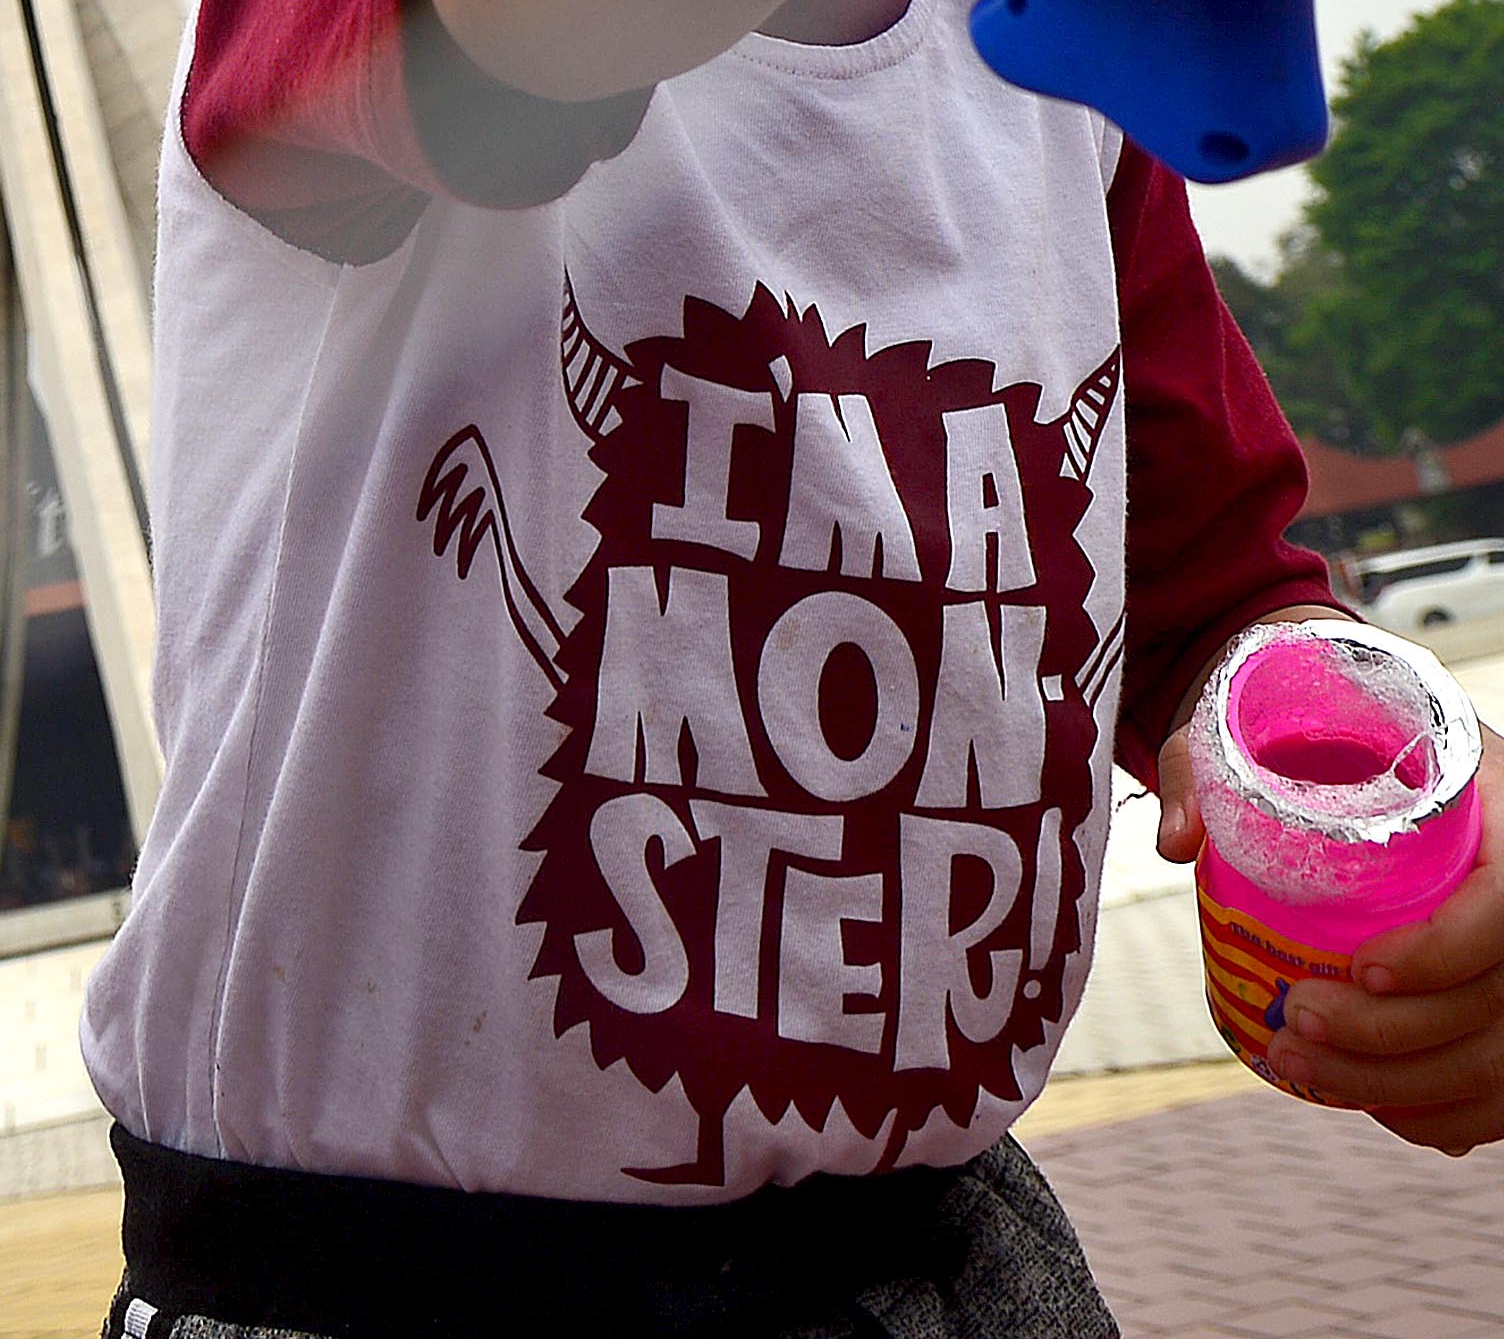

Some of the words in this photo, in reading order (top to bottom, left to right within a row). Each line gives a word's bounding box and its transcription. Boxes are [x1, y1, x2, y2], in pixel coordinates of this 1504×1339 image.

[650, 354, 923, 583] I'M
[941, 402, 1037, 594] A
[584, 564, 1064, 810] MON-
[572, 793, 1063, 1071] STER!
